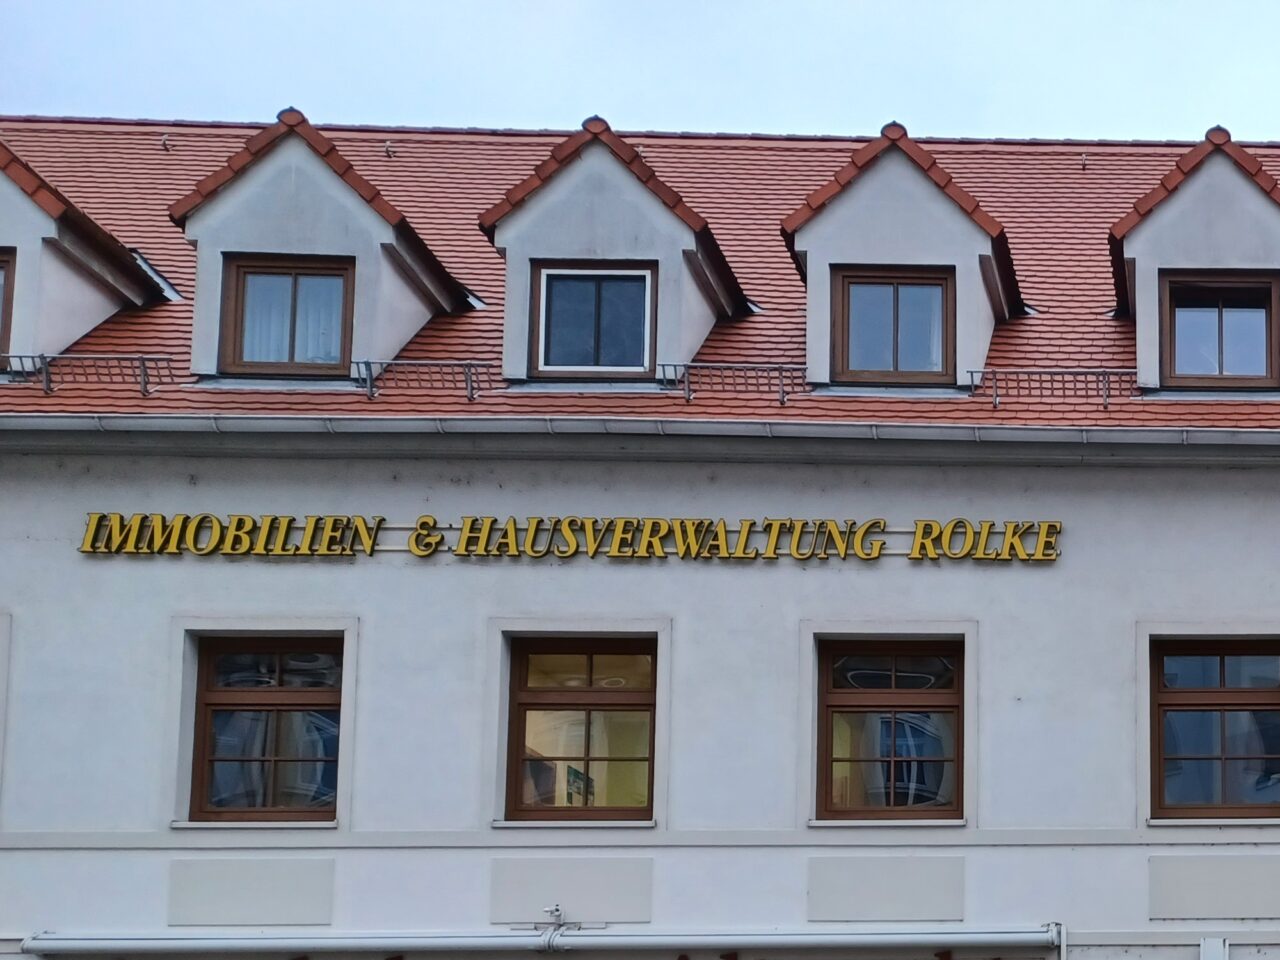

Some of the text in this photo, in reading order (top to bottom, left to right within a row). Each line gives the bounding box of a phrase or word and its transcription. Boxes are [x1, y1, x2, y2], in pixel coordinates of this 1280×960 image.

[79, 512, 1062, 560] IMMOBILIEN & HAUSVERWALTUNG ROLKE
